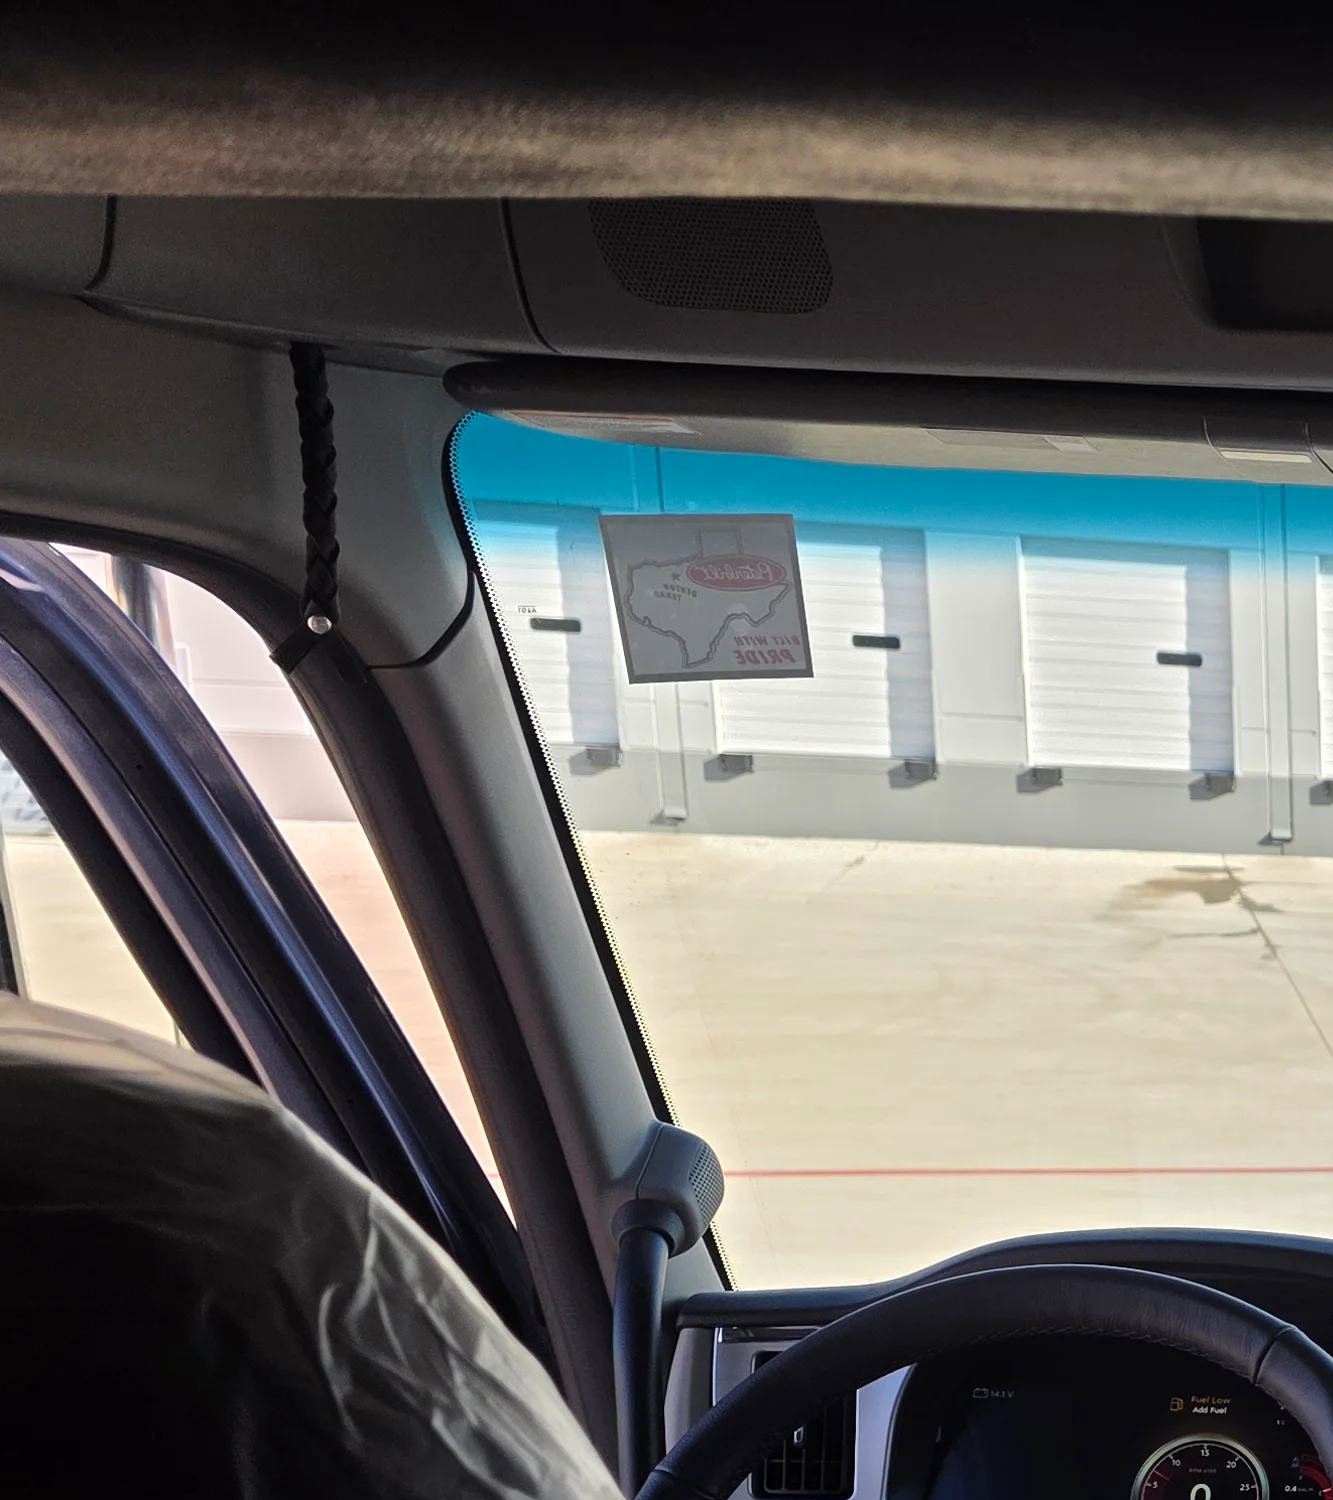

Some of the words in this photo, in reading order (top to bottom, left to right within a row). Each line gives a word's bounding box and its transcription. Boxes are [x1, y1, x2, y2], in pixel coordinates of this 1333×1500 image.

[1190, 1395, 1209, 1405] Fuel
[1211, 1396, 1232, 1405] Low
[1192, 1406, 1209, 1414] Add
[1210, 1406, 1228, 1414] Fuel
[1200, 1449, 1210, 1457] 15
[1171, 1459, 1181, 1467] 10
[1226, 1460, 1237, 1469] 20
